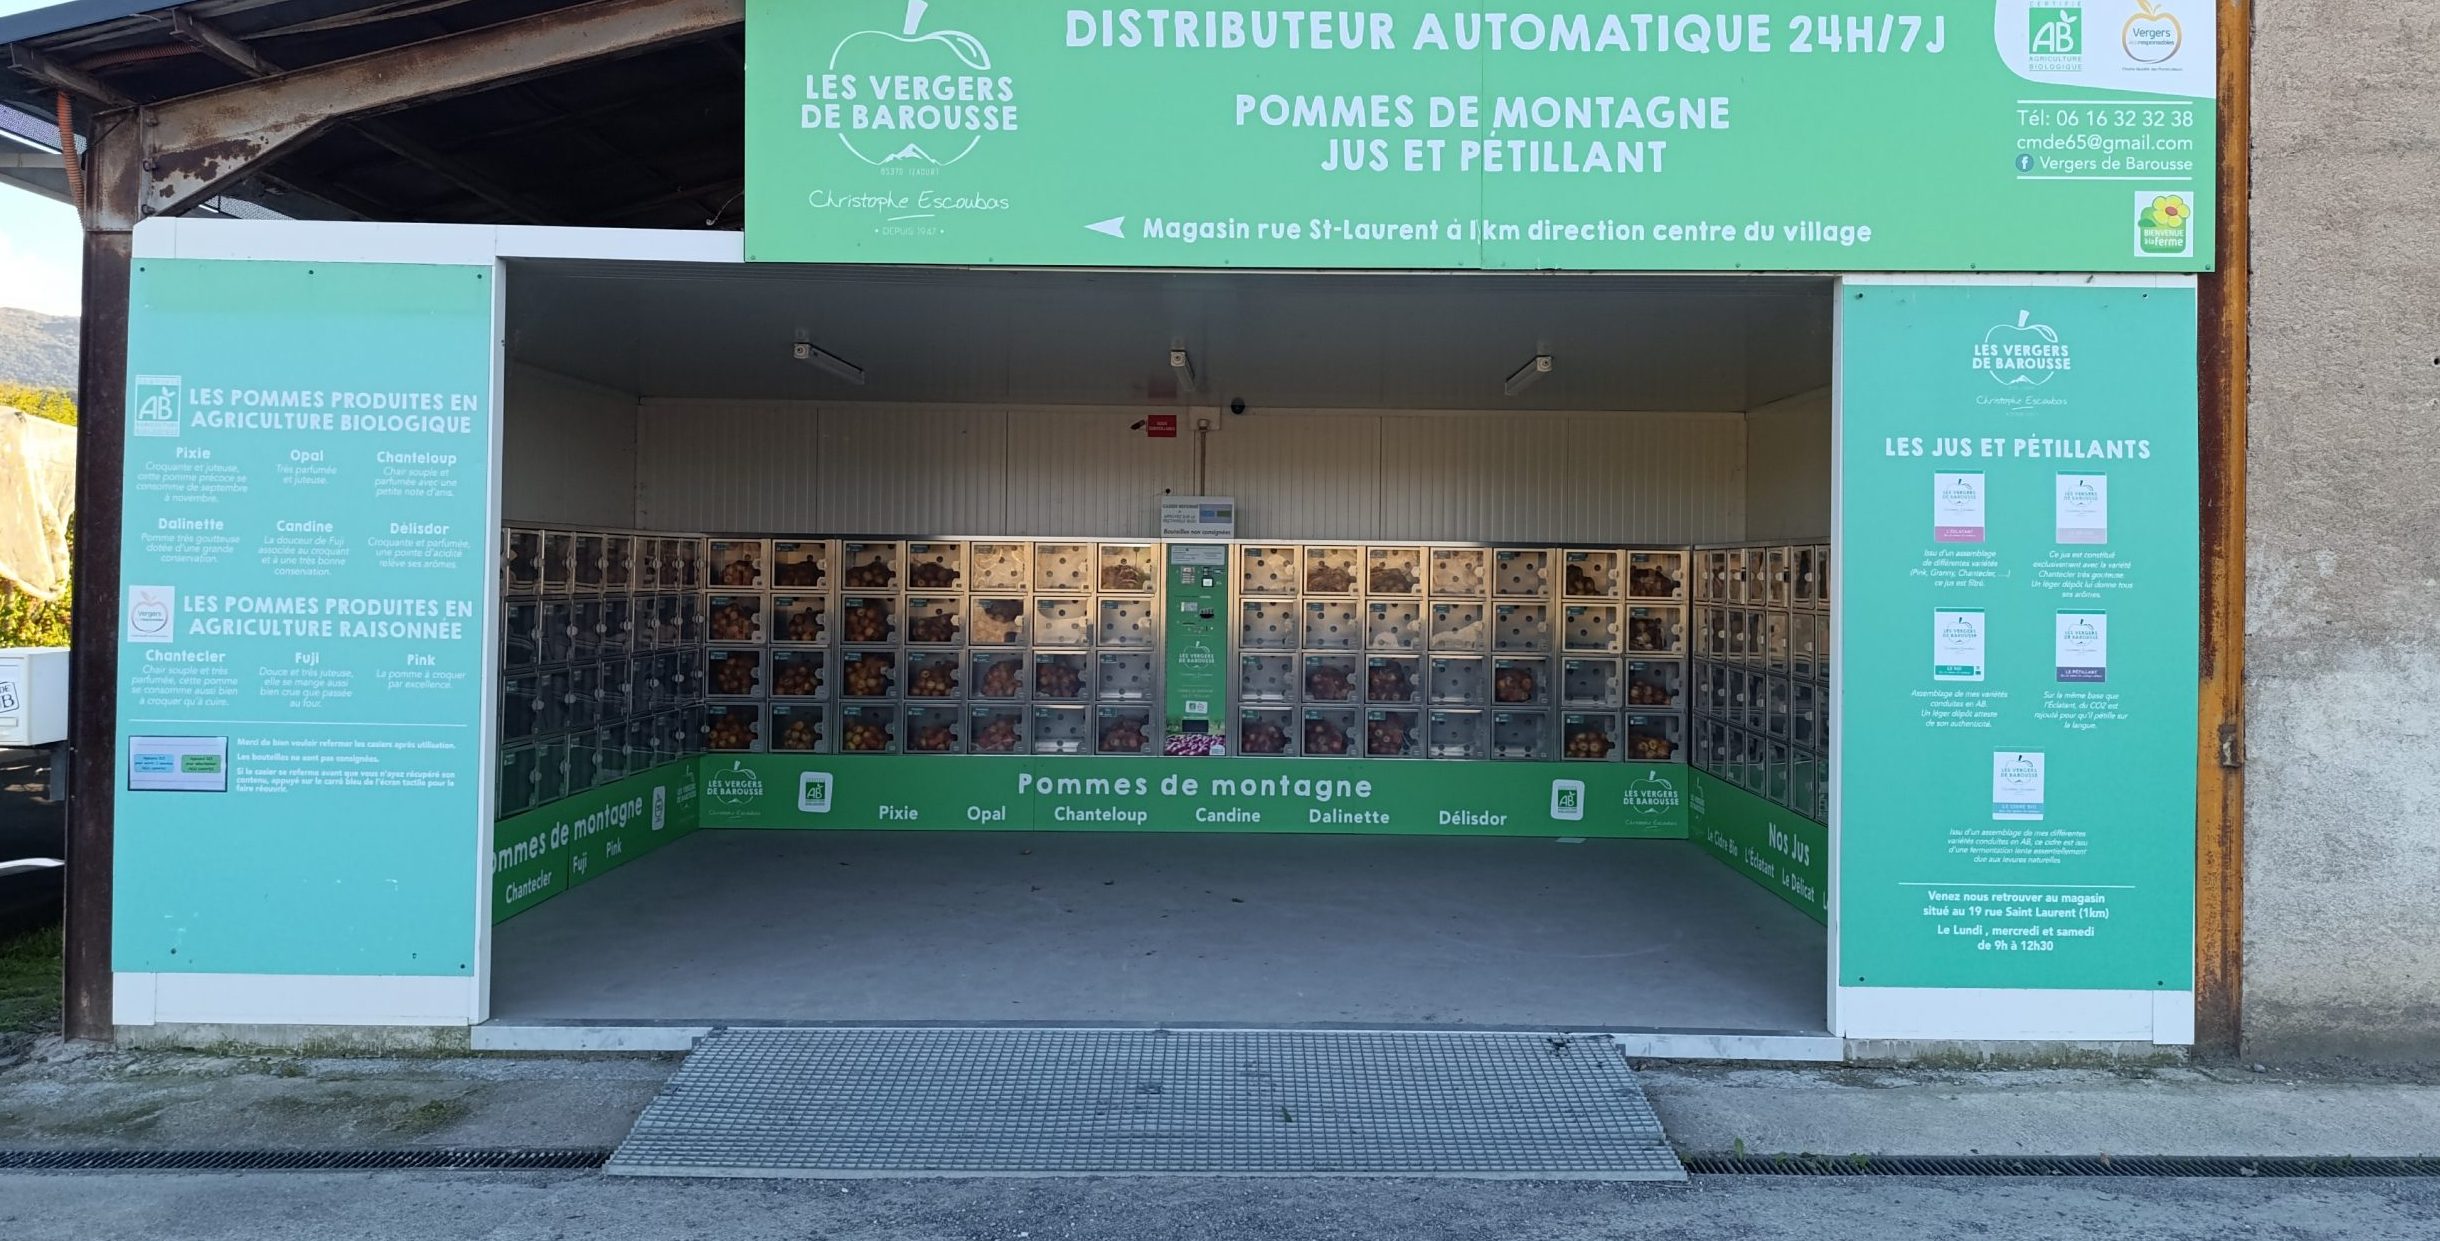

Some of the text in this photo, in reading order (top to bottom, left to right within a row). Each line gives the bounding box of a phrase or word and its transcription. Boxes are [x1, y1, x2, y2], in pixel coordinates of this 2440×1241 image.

[1065, 8, 1945, 54] DISTRIBUTEUR AUTOMATIQUE 24H/7J
[2032, 21, 2073, 52] AB
[2133, 27, 2171, 40] Vergers
[806, 73, 1014, 102] LES VERGERS
[801, 103, 1018, 131] DE BAROUSSE
[1236, 94, 1730, 130] POMMES DE MONTAGNE
[2016, 108, 2194, 128] Tél: 06 16 32 32 38
[1320, 129, 1669, 174] JUS ET PÉTILLANT
[2016, 133, 2193, 155] cmde65@gmail.com
[2039, 155, 2097, 174] Vergers
[2101, 155, 2121, 170] de
[2125, 156, 2194, 171] Barousse
[808, 189, 1010, 214] Christophe Escoubas
[1143, 217, 1250, 244] Magasin
[1257, 222, 1302, 240] rue
[1309, 218, 1439, 241] St-Laurent
[1446, 218, 1462, 241] à
[1527, 219, 1645, 241] direction
[1652, 220, 1737, 242] centre
[1743, 220, 1775, 242] du
[1783, 220, 1872, 247] village
[2144, 229, 2184, 237] BIENVENUE
[2155, 237, 2183, 246] ferme
[1974, 344, 2069, 356] LES VERGERS
[1972, 357, 2071, 370] DE BAROUSSE
[139, 395, 173, 419] AB
[189, 387, 478, 412] LES POMMES PRODUITES EN
[190, 409, 335, 431] AGRICULTURE
[340, 413, 471, 434] BIOLOGIQUE
[176, 447, 211, 460] Pixie
[1885, 433, 2151, 460] LES JUS ET PÉTILLANTS
[289, 449, 324, 464] Opal
[376, 450, 457, 467] Chanteloup
[158, 518, 224, 531] Dalinette
[276, 520, 333, 533] Candine
[390, 522, 449, 535] Délisdor
[183, 595, 473, 618] LES POMMES PRODUITES EN
[188, 617, 464, 640] AGRICULTURE RAISONNÉE
[144, 648, 226, 663] Chantecler
[295, 652, 319, 665] Fuji
[407, 654, 436, 666] Pink
[707, 788, 764, 796] DE BAROUSSE
[709, 780, 763, 788] LES VERGERS
[807, 785, 823, 799] AB
[1018, 773, 1372, 802] Pommes de montagne
[1560, 795, 1576, 807] AB
[1624, 797, 1634, 805] DE
[1637, 797, 1680, 806] BAROUSSE
[1641, 790, 1678, 798] VERGERS
[879, 805, 1508, 826] Pixie Opal Chanteloup Candine Dalinette Délisdor
[492, 797, 642, 875] ommes de montagne
[1769, 821, 1810, 867] Nos Jus
[505, 837, 622, 904] Chantecler Fuji Pink
[1792, 872, 1815, 902] Délicat
[1928, 890, 2105, 906] Venez nous retrouver au magasin
[1923, 905, 2109, 920] situé au 19 rue Saint Laurent (1km)
[1937, 923, 1950, 935] Le
[1953, 924, 1982, 936] Lundi
[1992, 925, 2039, 936] mercredi
[2042, 927, 2053, 936] et
[2056, 926, 2095, 937] samedi
[1977, 940, 2054, 952] de 9h à 12h30
